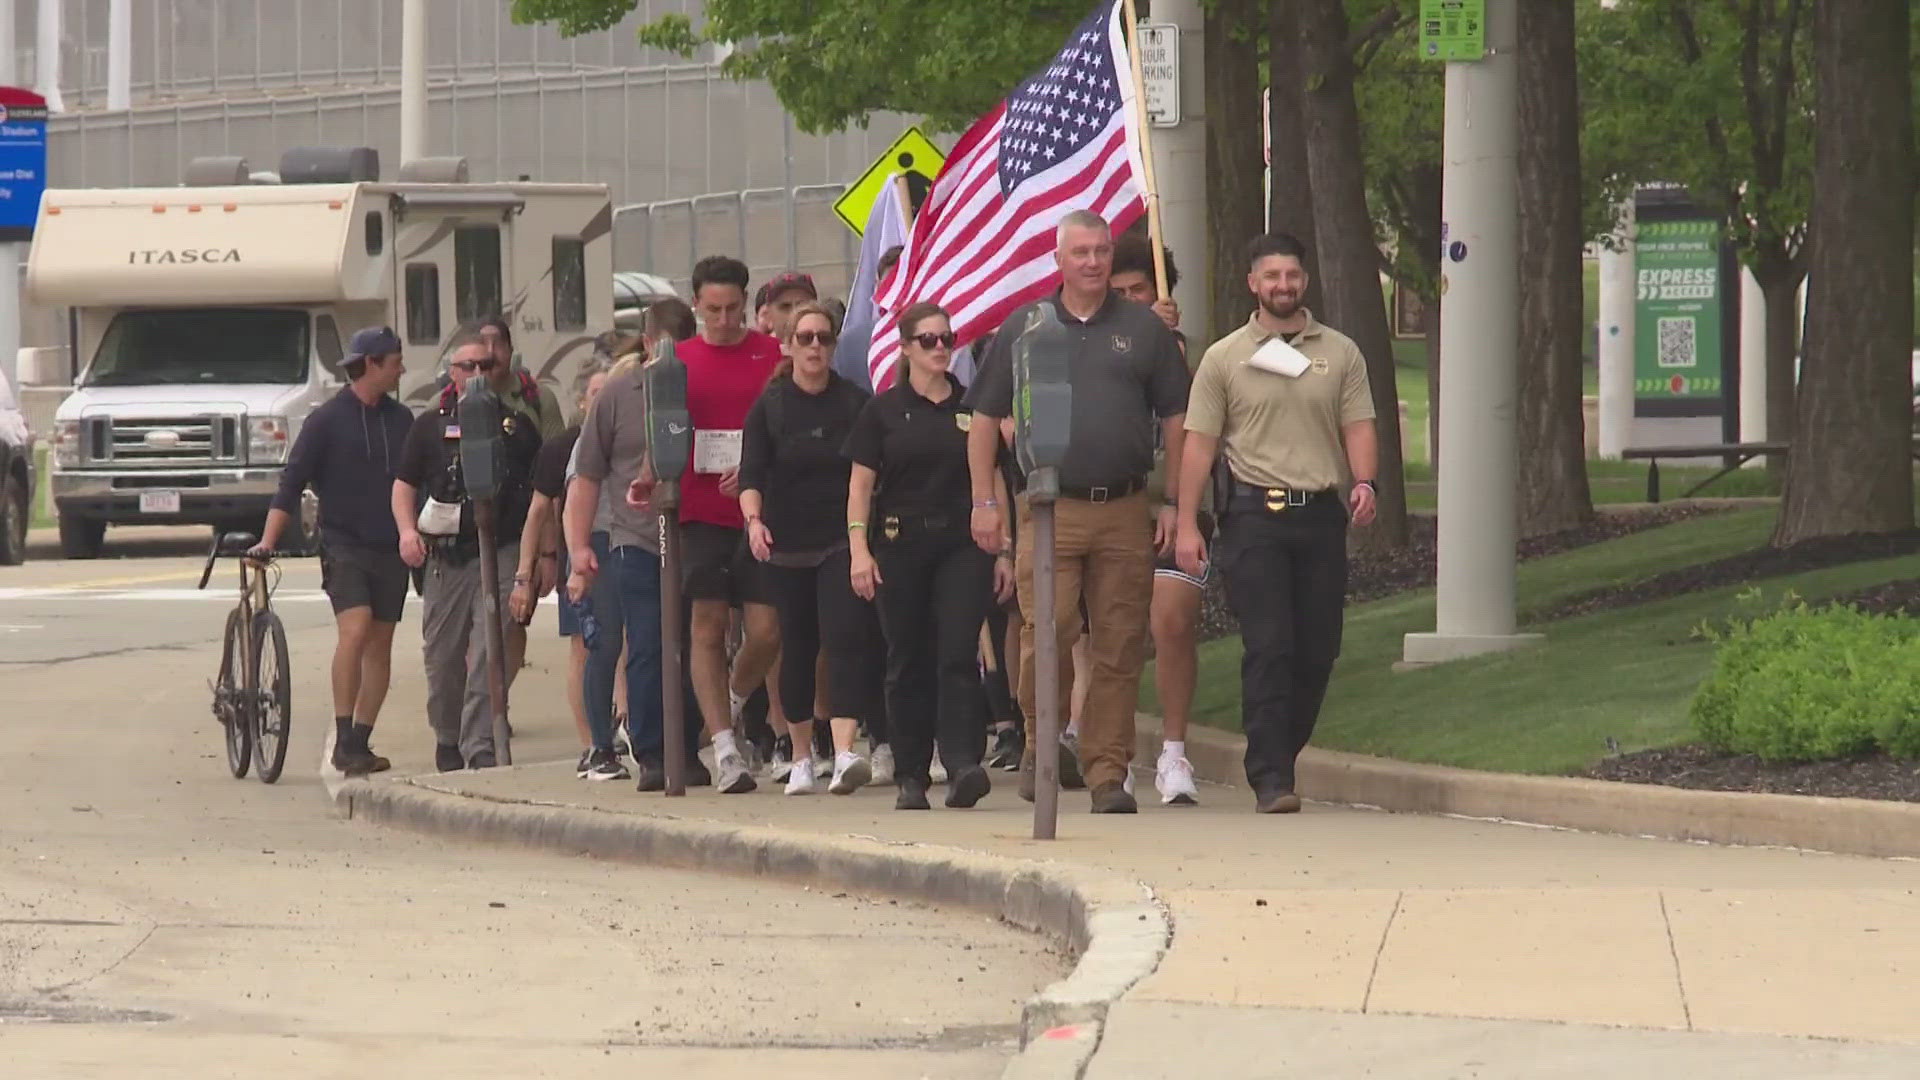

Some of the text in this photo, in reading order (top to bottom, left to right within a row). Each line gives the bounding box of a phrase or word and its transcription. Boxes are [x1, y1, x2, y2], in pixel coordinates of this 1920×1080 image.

[1144, 31, 1163, 45] TWO
[1144, 66, 1173, 80] RKING
[2, 126, 38, 136] Stadium
[128, 248, 241, 264] ITASCA
[1638, 268, 1716, 285] EXPRESS
[658, 514, 667, 569] 0221
